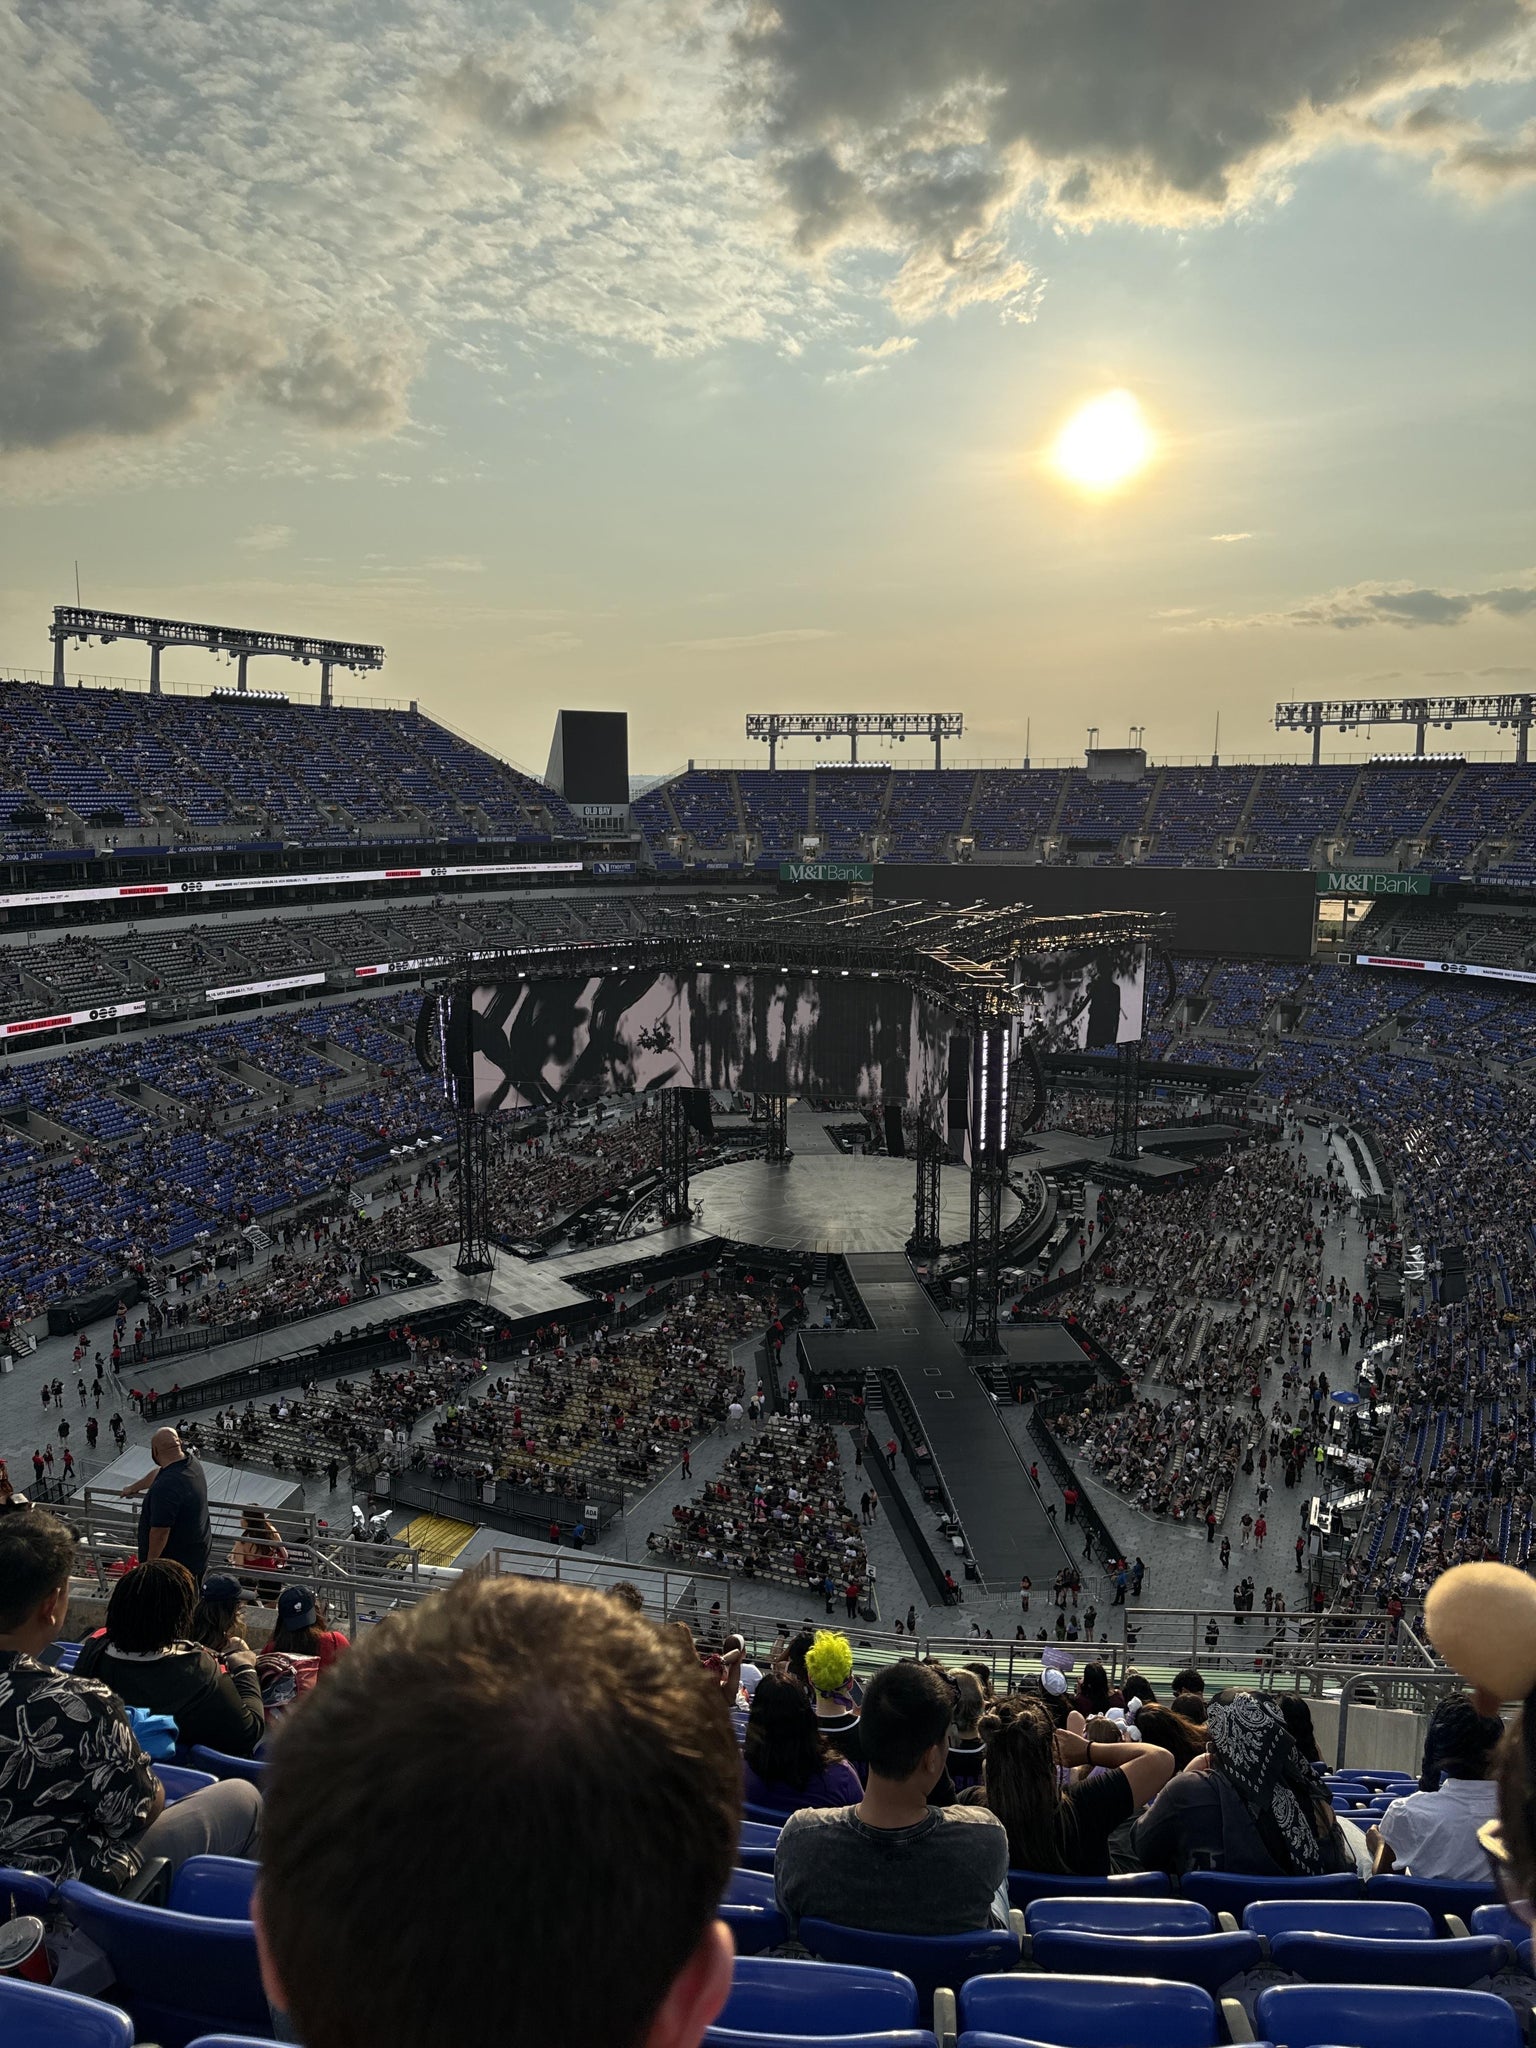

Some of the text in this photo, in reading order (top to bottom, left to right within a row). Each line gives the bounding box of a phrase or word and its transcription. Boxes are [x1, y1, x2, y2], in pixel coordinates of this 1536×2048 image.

[585, 807, 611, 815] OLD BAY
[789, 865, 864, 880] M&T Bank
[1327, 873, 1418, 894] M&T Bank
